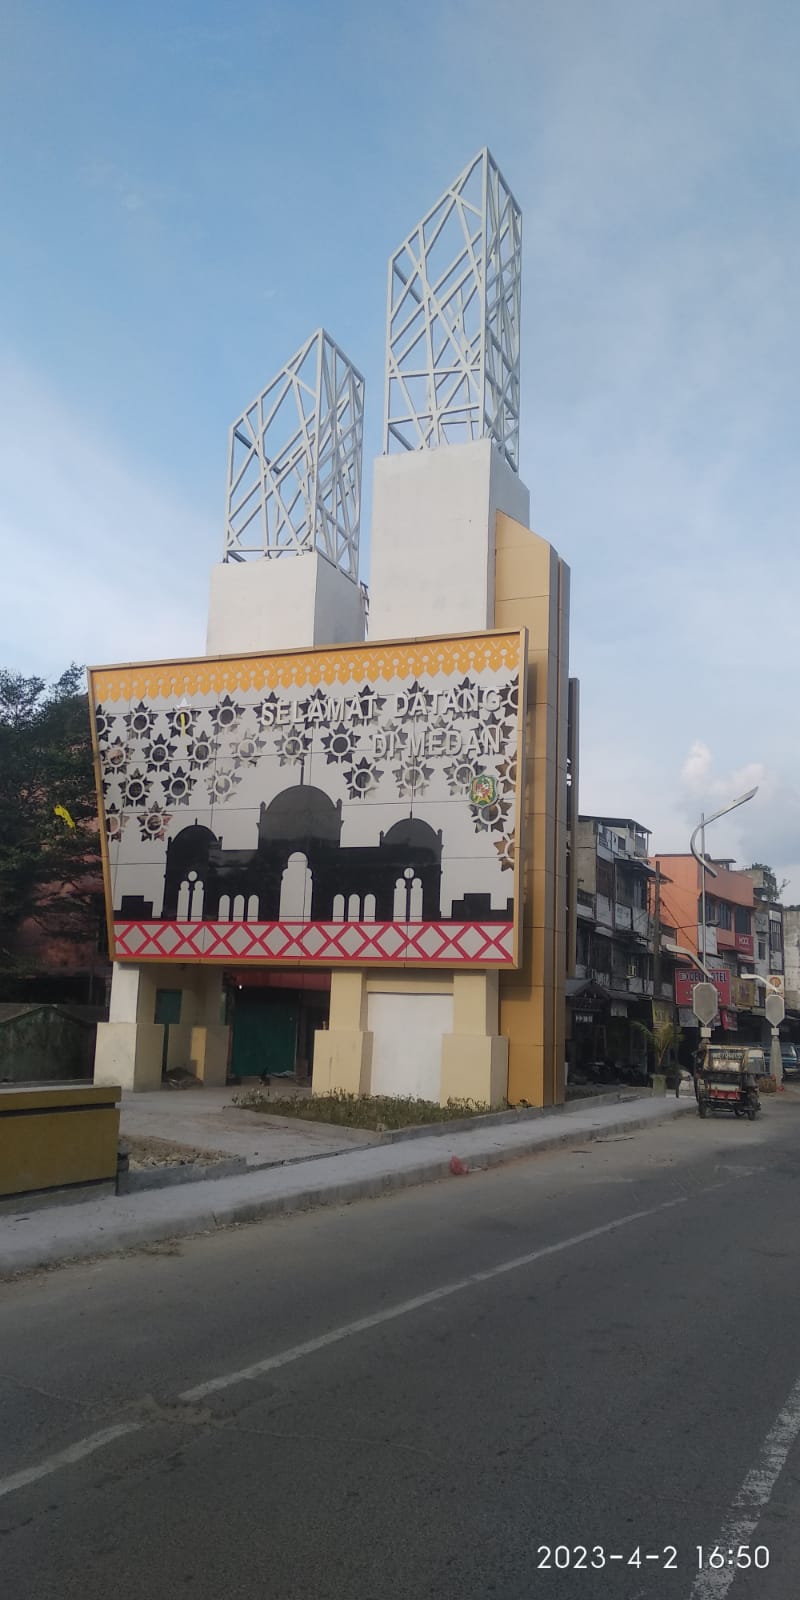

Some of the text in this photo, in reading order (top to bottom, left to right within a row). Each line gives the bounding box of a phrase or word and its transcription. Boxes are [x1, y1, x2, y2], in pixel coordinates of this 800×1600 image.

[261, 686, 502, 726] SELAMAT DATANG
[372, 726, 502, 758] DI MEDAN
